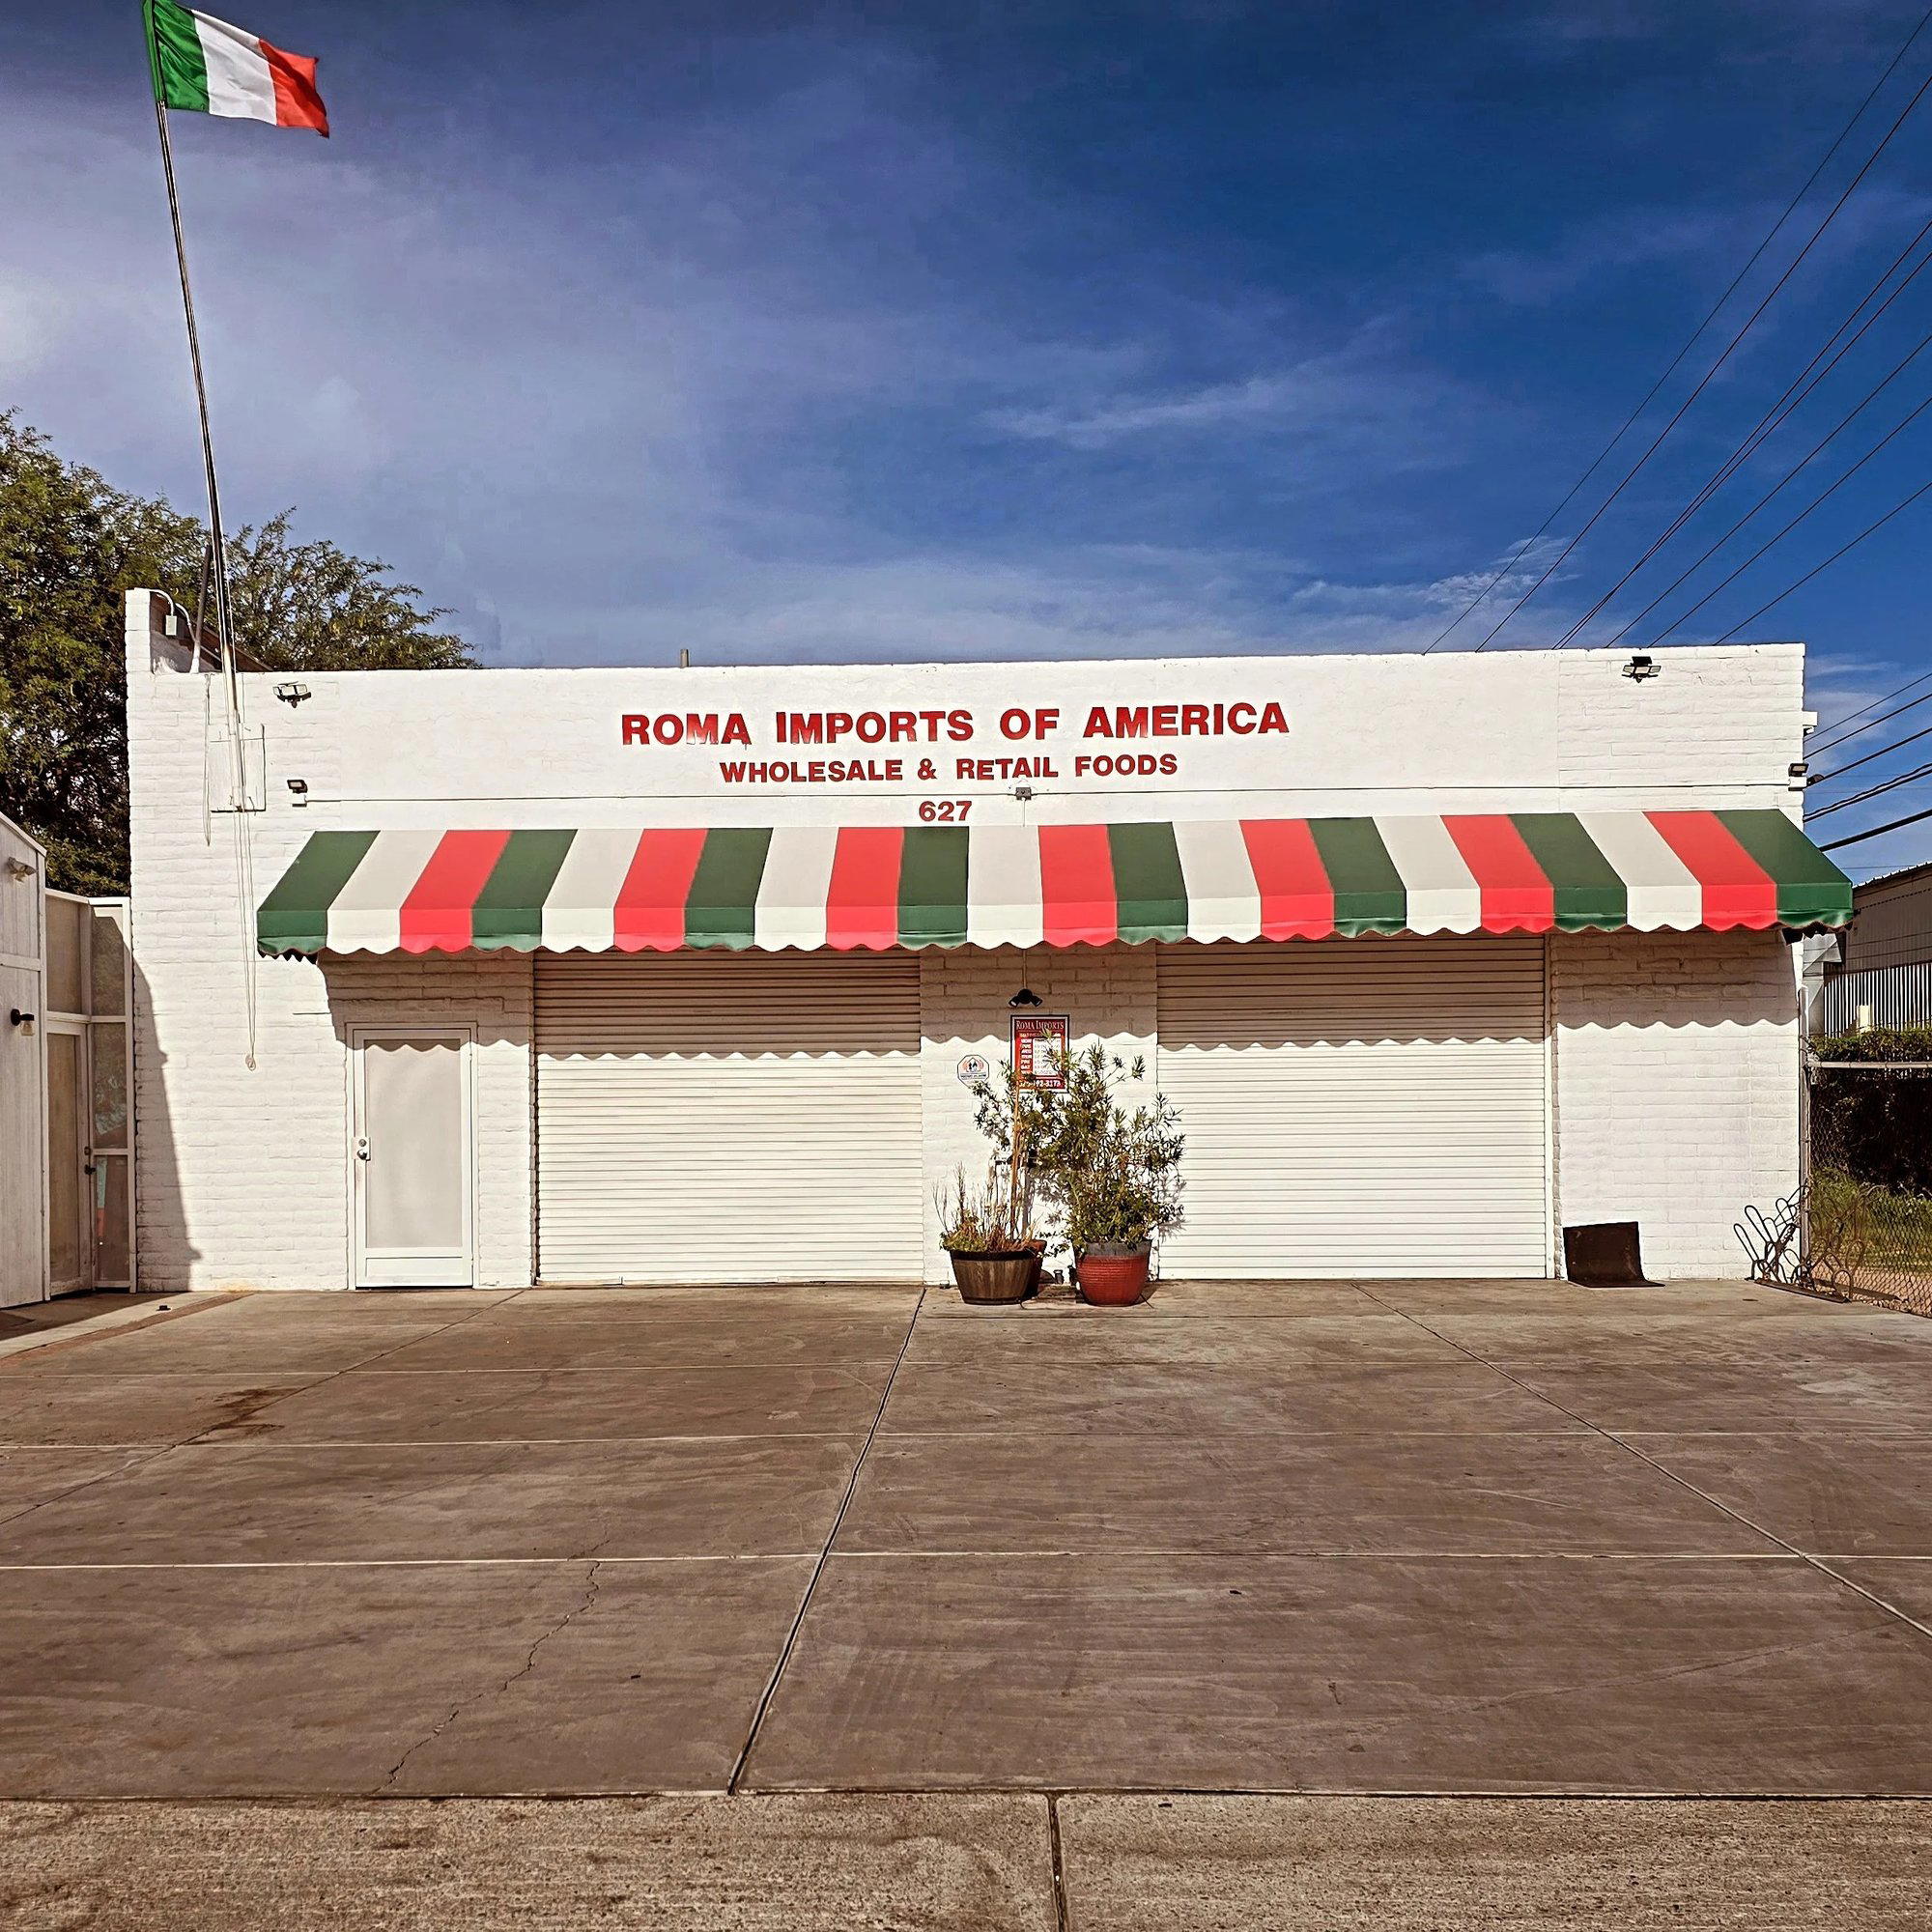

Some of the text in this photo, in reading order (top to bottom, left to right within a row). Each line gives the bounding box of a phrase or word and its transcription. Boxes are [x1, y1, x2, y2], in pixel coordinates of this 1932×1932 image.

[621, 702, 1290, 746] ROMA IMPORTS OF AMERICA
[720, 753, 1179, 783] WHOLESALE & RETAIL FOODS
[918, 800, 973, 822] 627
[1015, 1020, 1035, 1030] ROMA
